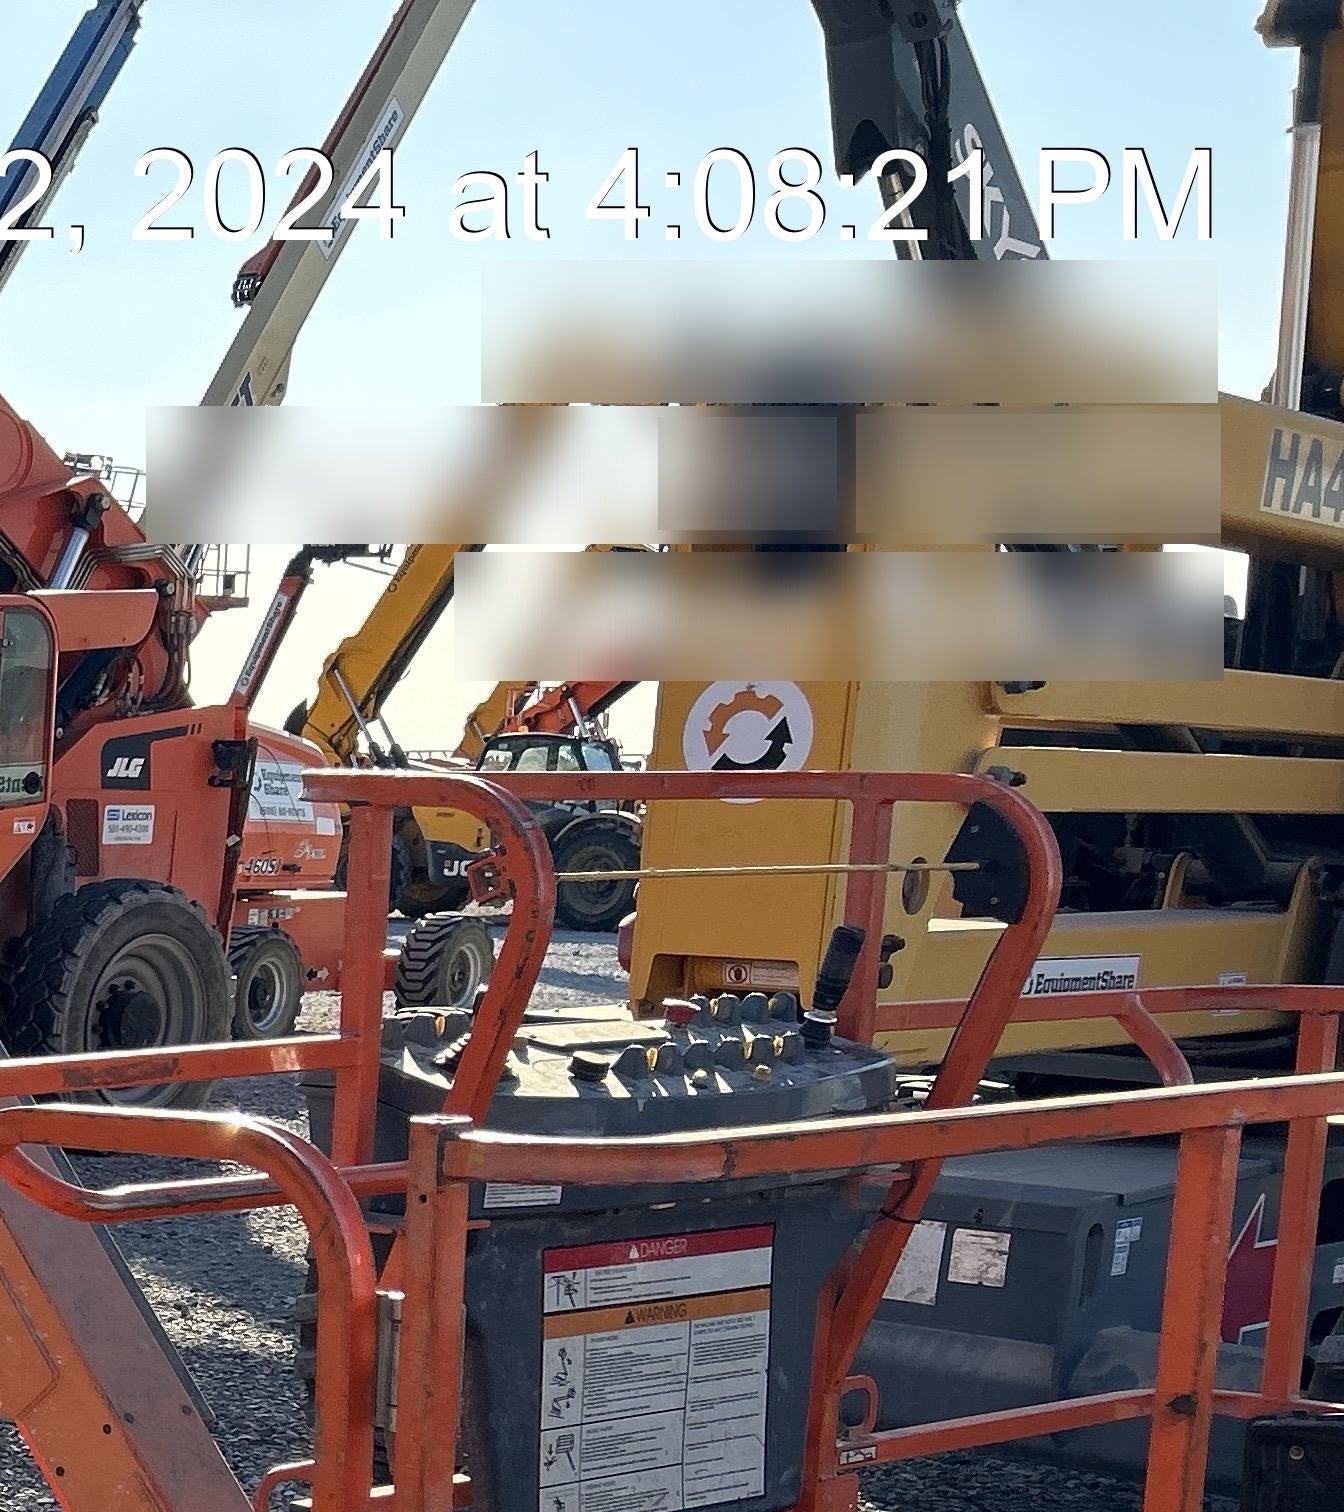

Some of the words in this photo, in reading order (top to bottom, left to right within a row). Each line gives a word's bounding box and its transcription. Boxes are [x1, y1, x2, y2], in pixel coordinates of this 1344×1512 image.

[107, 757, 145, 778] JLG
[121, 809, 152, 822] Lexicon
[639, 1238, 688, 1259] DANGER
[636, 1303, 688, 1323] WARNING
